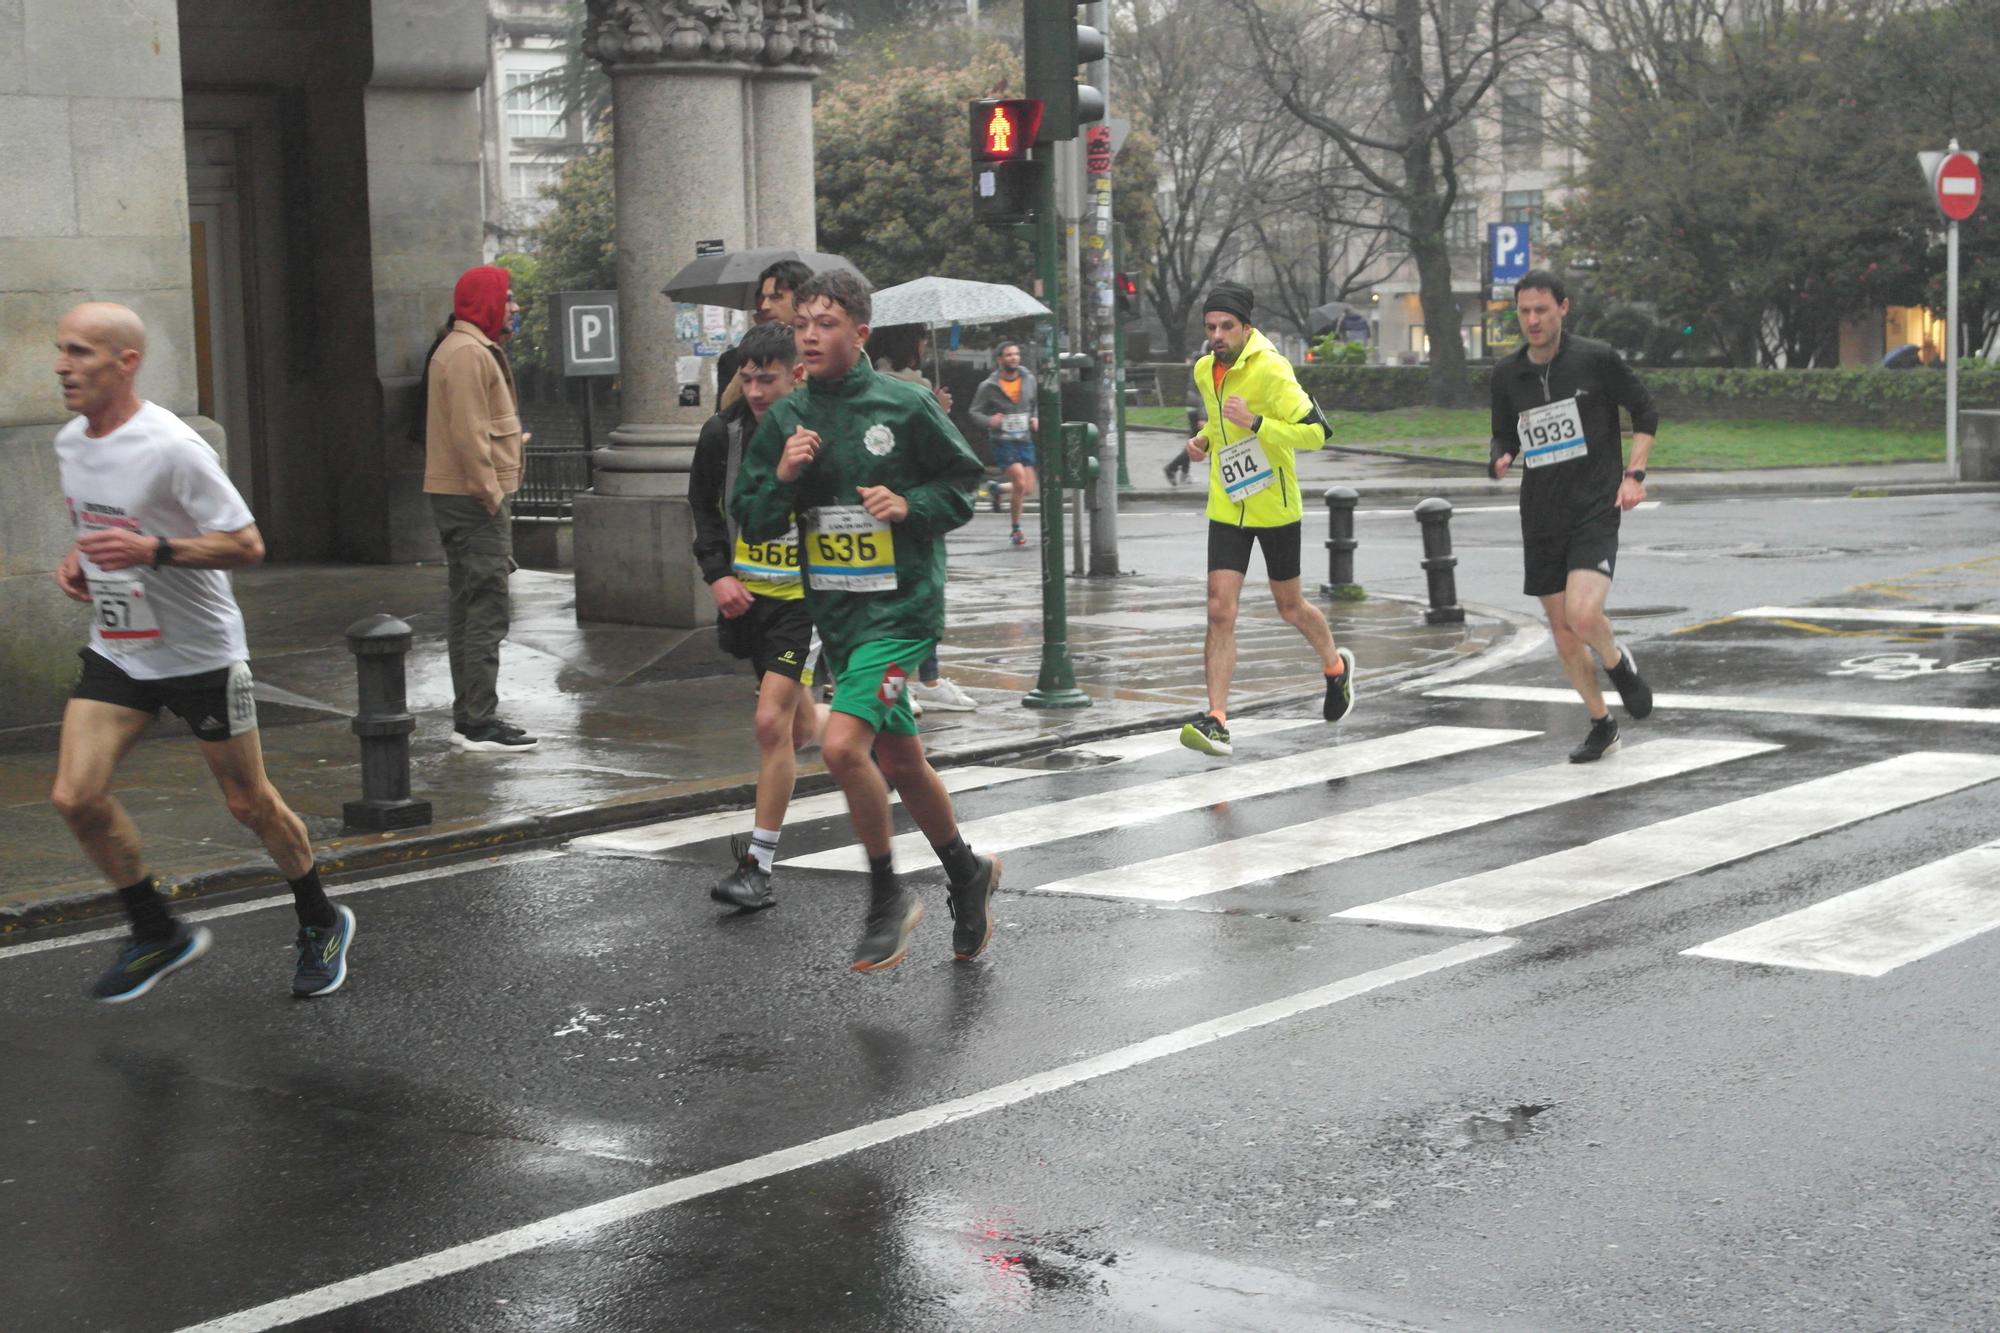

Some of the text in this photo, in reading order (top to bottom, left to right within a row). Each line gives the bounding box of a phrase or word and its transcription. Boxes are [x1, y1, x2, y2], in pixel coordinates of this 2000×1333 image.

[1496, 225, 1518, 266] P
[581, 314, 602, 352] P
[1523, 418, 1577, 448] 1933
[1222, 454, 1258, 484] 814
[817, 532, 878, 562] 636
